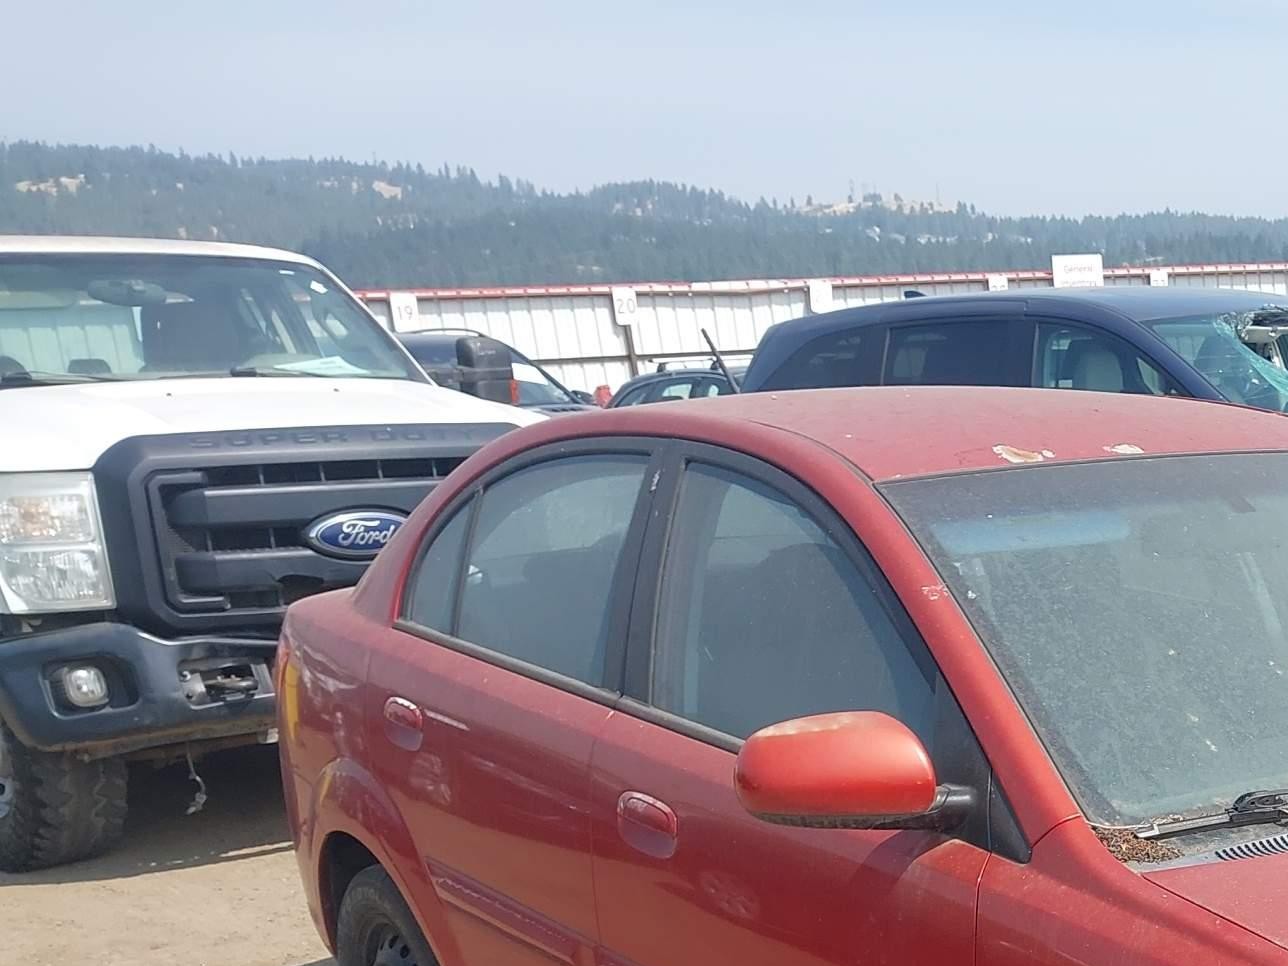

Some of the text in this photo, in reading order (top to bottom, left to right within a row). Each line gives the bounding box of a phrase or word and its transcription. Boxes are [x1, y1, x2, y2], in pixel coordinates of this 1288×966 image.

[397, 305, 413, 320] 19
[616, 298, 636, 314] 20
[190, 426, 475, 448] SUPER DUTY
[338, 520, 395, 546] Ford
